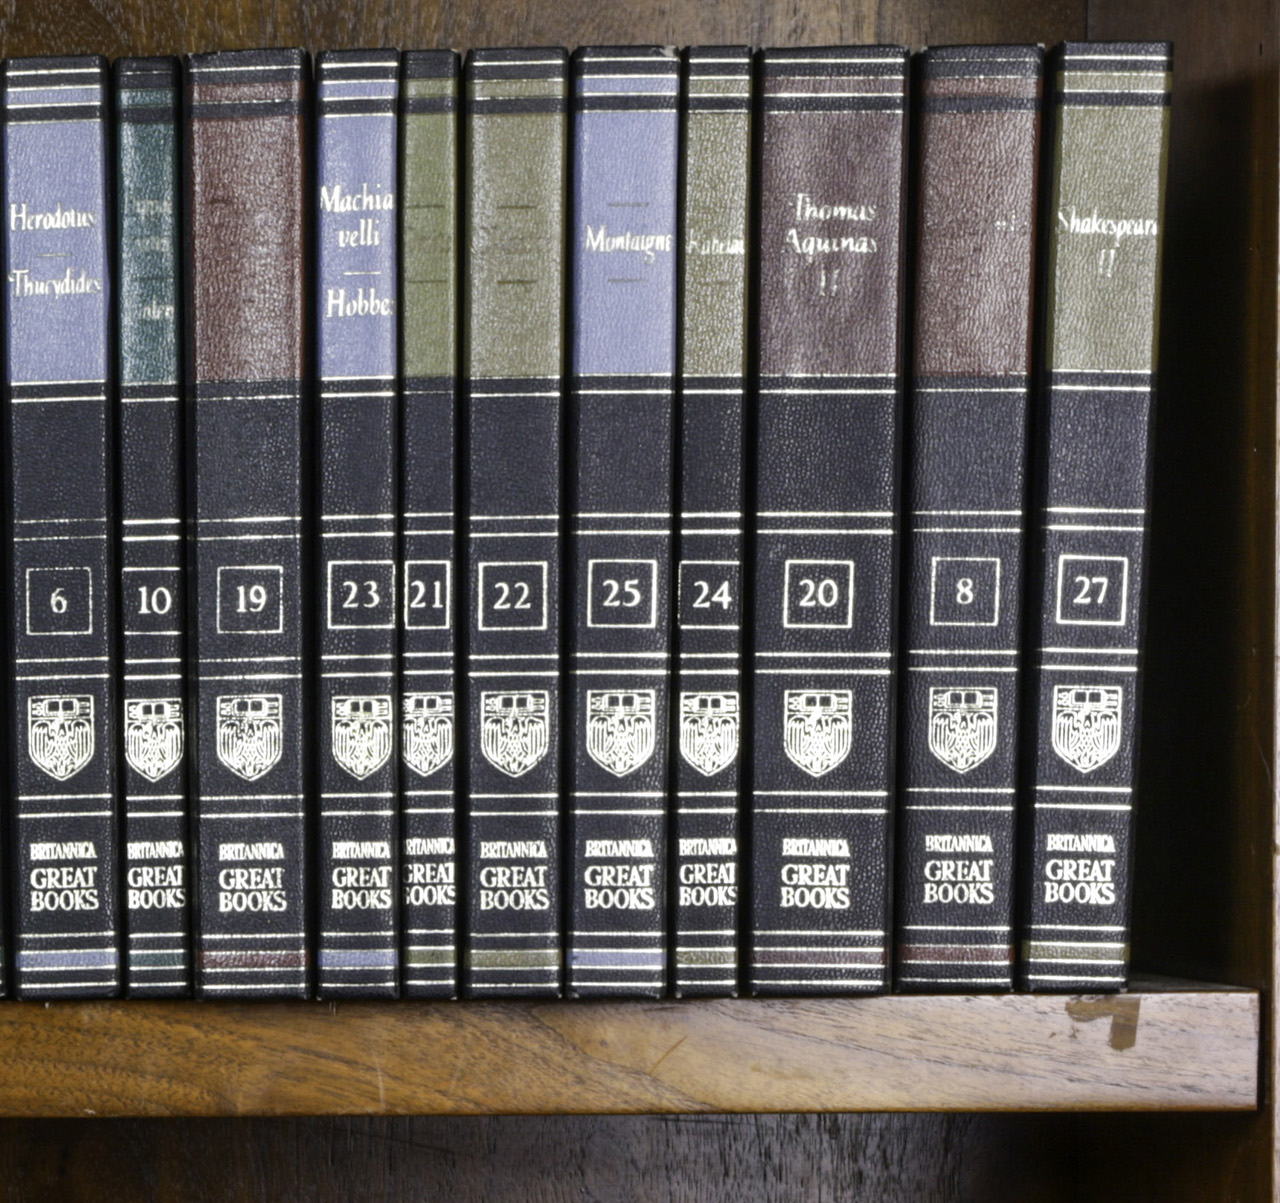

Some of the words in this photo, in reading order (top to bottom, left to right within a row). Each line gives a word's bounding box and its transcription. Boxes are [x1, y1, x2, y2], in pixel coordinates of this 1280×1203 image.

[321, 183, 393, 214] Machia
[338, 218, 380, 249] velli
[139, 586, 172, 614] 10
[342, 581, 380, 608] 23
[1073, 576, 1109, 604] 27
